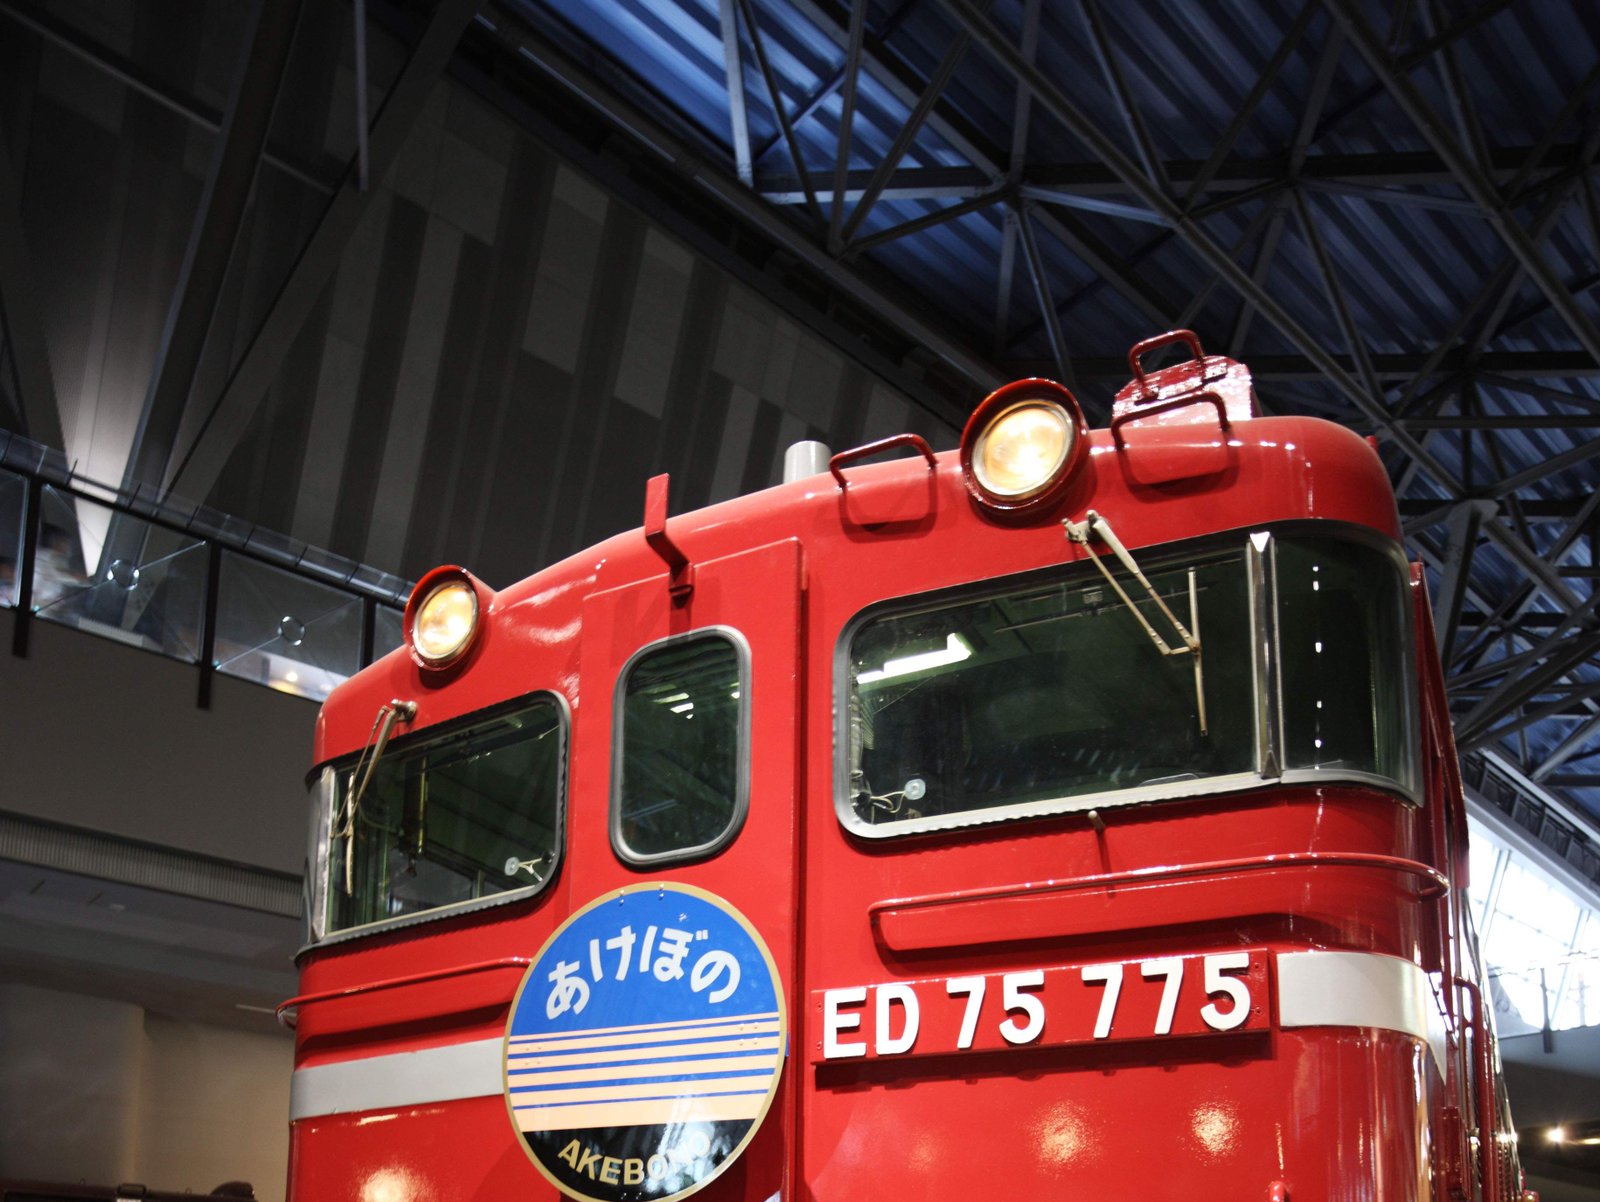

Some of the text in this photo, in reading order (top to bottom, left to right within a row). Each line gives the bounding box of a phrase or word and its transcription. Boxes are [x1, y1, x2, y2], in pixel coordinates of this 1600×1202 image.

[546, 925, 741, 1020] あけぼの
[823, 953, 1252, 1059] ED 75 775
